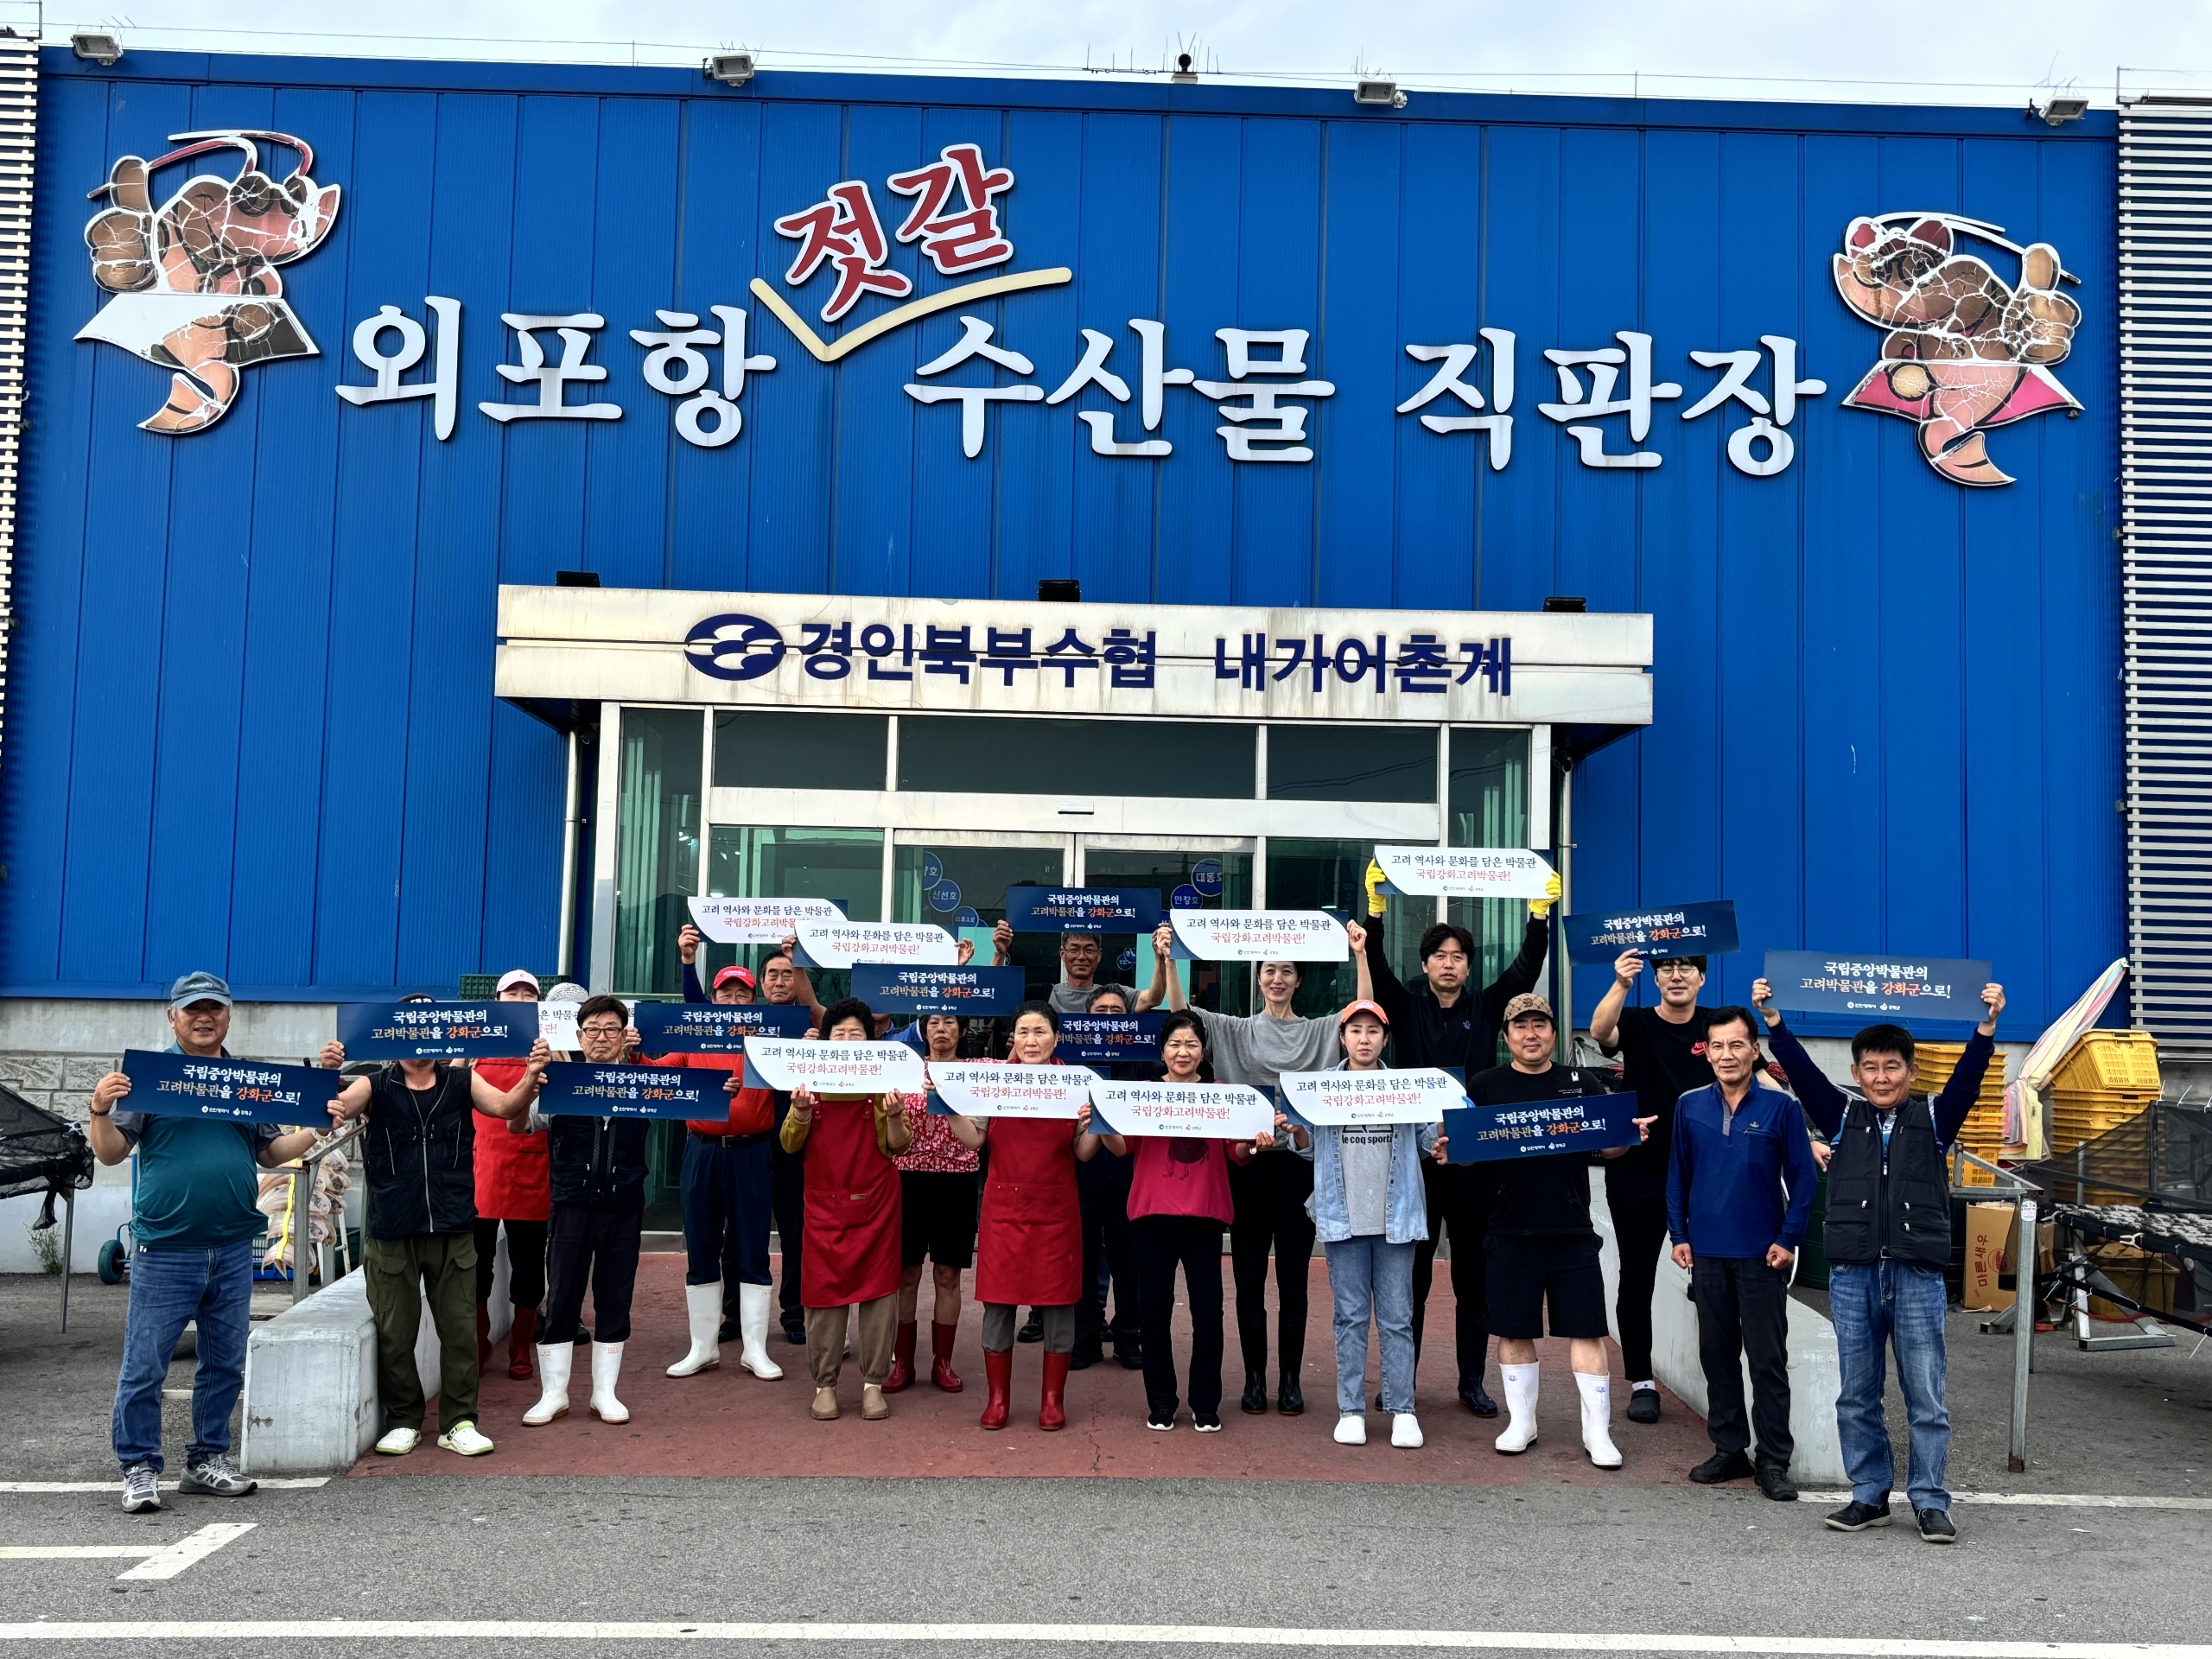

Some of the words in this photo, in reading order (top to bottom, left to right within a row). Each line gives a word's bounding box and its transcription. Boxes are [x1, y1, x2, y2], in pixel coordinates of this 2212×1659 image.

[774, 143, 1014, 321] 젓갈
[335, 296, 776, 447] 외포항
[904, 316, 1335, 461] 수산물
[1396, 327, 1827, 475] 직판장
[800, 622, 1156, 689] 경인북부수협
[1216, 632, 1511, 696] 내가어촌계
[1391, 855, 1411, 866] 고려
[1415, 855, 1446, 866] 역사와
[1448, 855, 1478, 868] 문화를
[1482, 856, 1503, 868] 담은
[1505, 857, 1536, 868] 박물관
[1416, 869, 1510, 881] 국립강화고려박물관!
[1047, 894, 1119, 906] 국립중앙박물관의
[1031, 906, 1085, 917] 고려박물관을
[1088, 907, 1135, 918] 강화군으로!
[724, 918, 797, 928] 국립강화고려박물
[1186, 918, 1206, 929] 고려
[1210, 918, 1241, 930] 역사와
[1243, 918, 1274, 930] 문화를
[1277, 919, 1297, 930] 담은
[1300, 919, 1332, 931] 박물관
[1604, 912, 1685, 931] 국립중앙박물관의
[1211, 931, 1305, 944] 국립강화고려박물관!
[1591, 931, 1646, 945] 고려박물관을
[1649, 925, 1706, 941] 강화군으로!
[898, 972, 976, 984] 국립중앙박물관의
[1824, 962, 1928, 980] 국립중앙박물관의
[880, 985, 939, 997] 고려박물관을
[942, 987, 995, 999] 강화군으로!
[1800, 977, 1878, 994] 고려박물관을
[1881, 982, 1951, 999] 강화군으로!
[393, 1010, 486, 1024] 국립중앙박물관의
[538, 1009, 550, 1020] 은
[682, 1011, 762, 1023] 국립중앙박물관의
[371, 1026, 442, 1040] 고려박물관을
[446, 1026, 507, 1039] 강화군으로!
[663, 1025, 724, 1036] 고려박물관을
[727, 1026, 780, 1037] 강화군으로!
[1063, 1020, 1138, 1032] 국립중앙박물관의
[1058, 1033, 1103, 1045] 려박물관을
[1105, 1034, 1155, 1045] 강화군으로!
[761, 1047, 781, 1058] 고려
[785, 1047, 817, 1059] 역사와
[819, 1049, 850, 1061] 문화를
[854, 1050, 874, 1061] 담은
[878, 1050, 908, 1061] 박물관
[183, 1065, 282, 1087] 국립중앙박물관의
[786, 1062, 882, 1076] 국립강화고려박물관!
[594, 1071, 681, 1086] 국립중앙박물관의
[944, 1071, 965, 1084] 고려
[969, 1071, 1001, 1084] 역사와
[1003, 1072, 1035, 1084] 문화를
[1038, 1073, 1058, 1085] 담은
[1061, 1074, 1093, 1086] 박물관
[1296, 1081, 1316, 1092] 고려
[1320, 1080, 1352, 1092] 역사와
[1355, 1079, 1387, 1091] 문화를
[1390, 1078, 1412, 1090] 담은
[1414, 1077, 1447, 1089] 박물관
[156, 1081, 232, 1098] 고려박물관을
[236, 1087, 301, 1105] 강화군으로!
[572, 1085, 639, 1098] 고려박물관을
[641, 1088, 699, 1102] 강화군으로!
[969, 1086, 1066, 1100] 국립강화고려박물관!
[1105, 1090, 1126, 1102] 고려
[1130, 1090, 1162, 1103] 역사와
[1165, 1091, 1197, 1104] 문화를
[1200, 1092, 1222, 1104] 담은
[1224, 1093, 1257, 1105] 박물관
[1322, 1092, 1421, 1107] 국립강화고려박물관!
[1131, 1105, 1230, 1120] 국립강화고려박물관!
[1495, 1105, 1584, 1125] 국립중앙박물관의
[1477, 1124, 1544, 1141] 고려박물관을
[1547, 1118, 1606, 1135] 강화군으로!
[1343, 1134, 1349, 1144] le
[1350, 1136, 1365, 1145] coq
[1975, 1234, 1988, 1287] 마른새우
